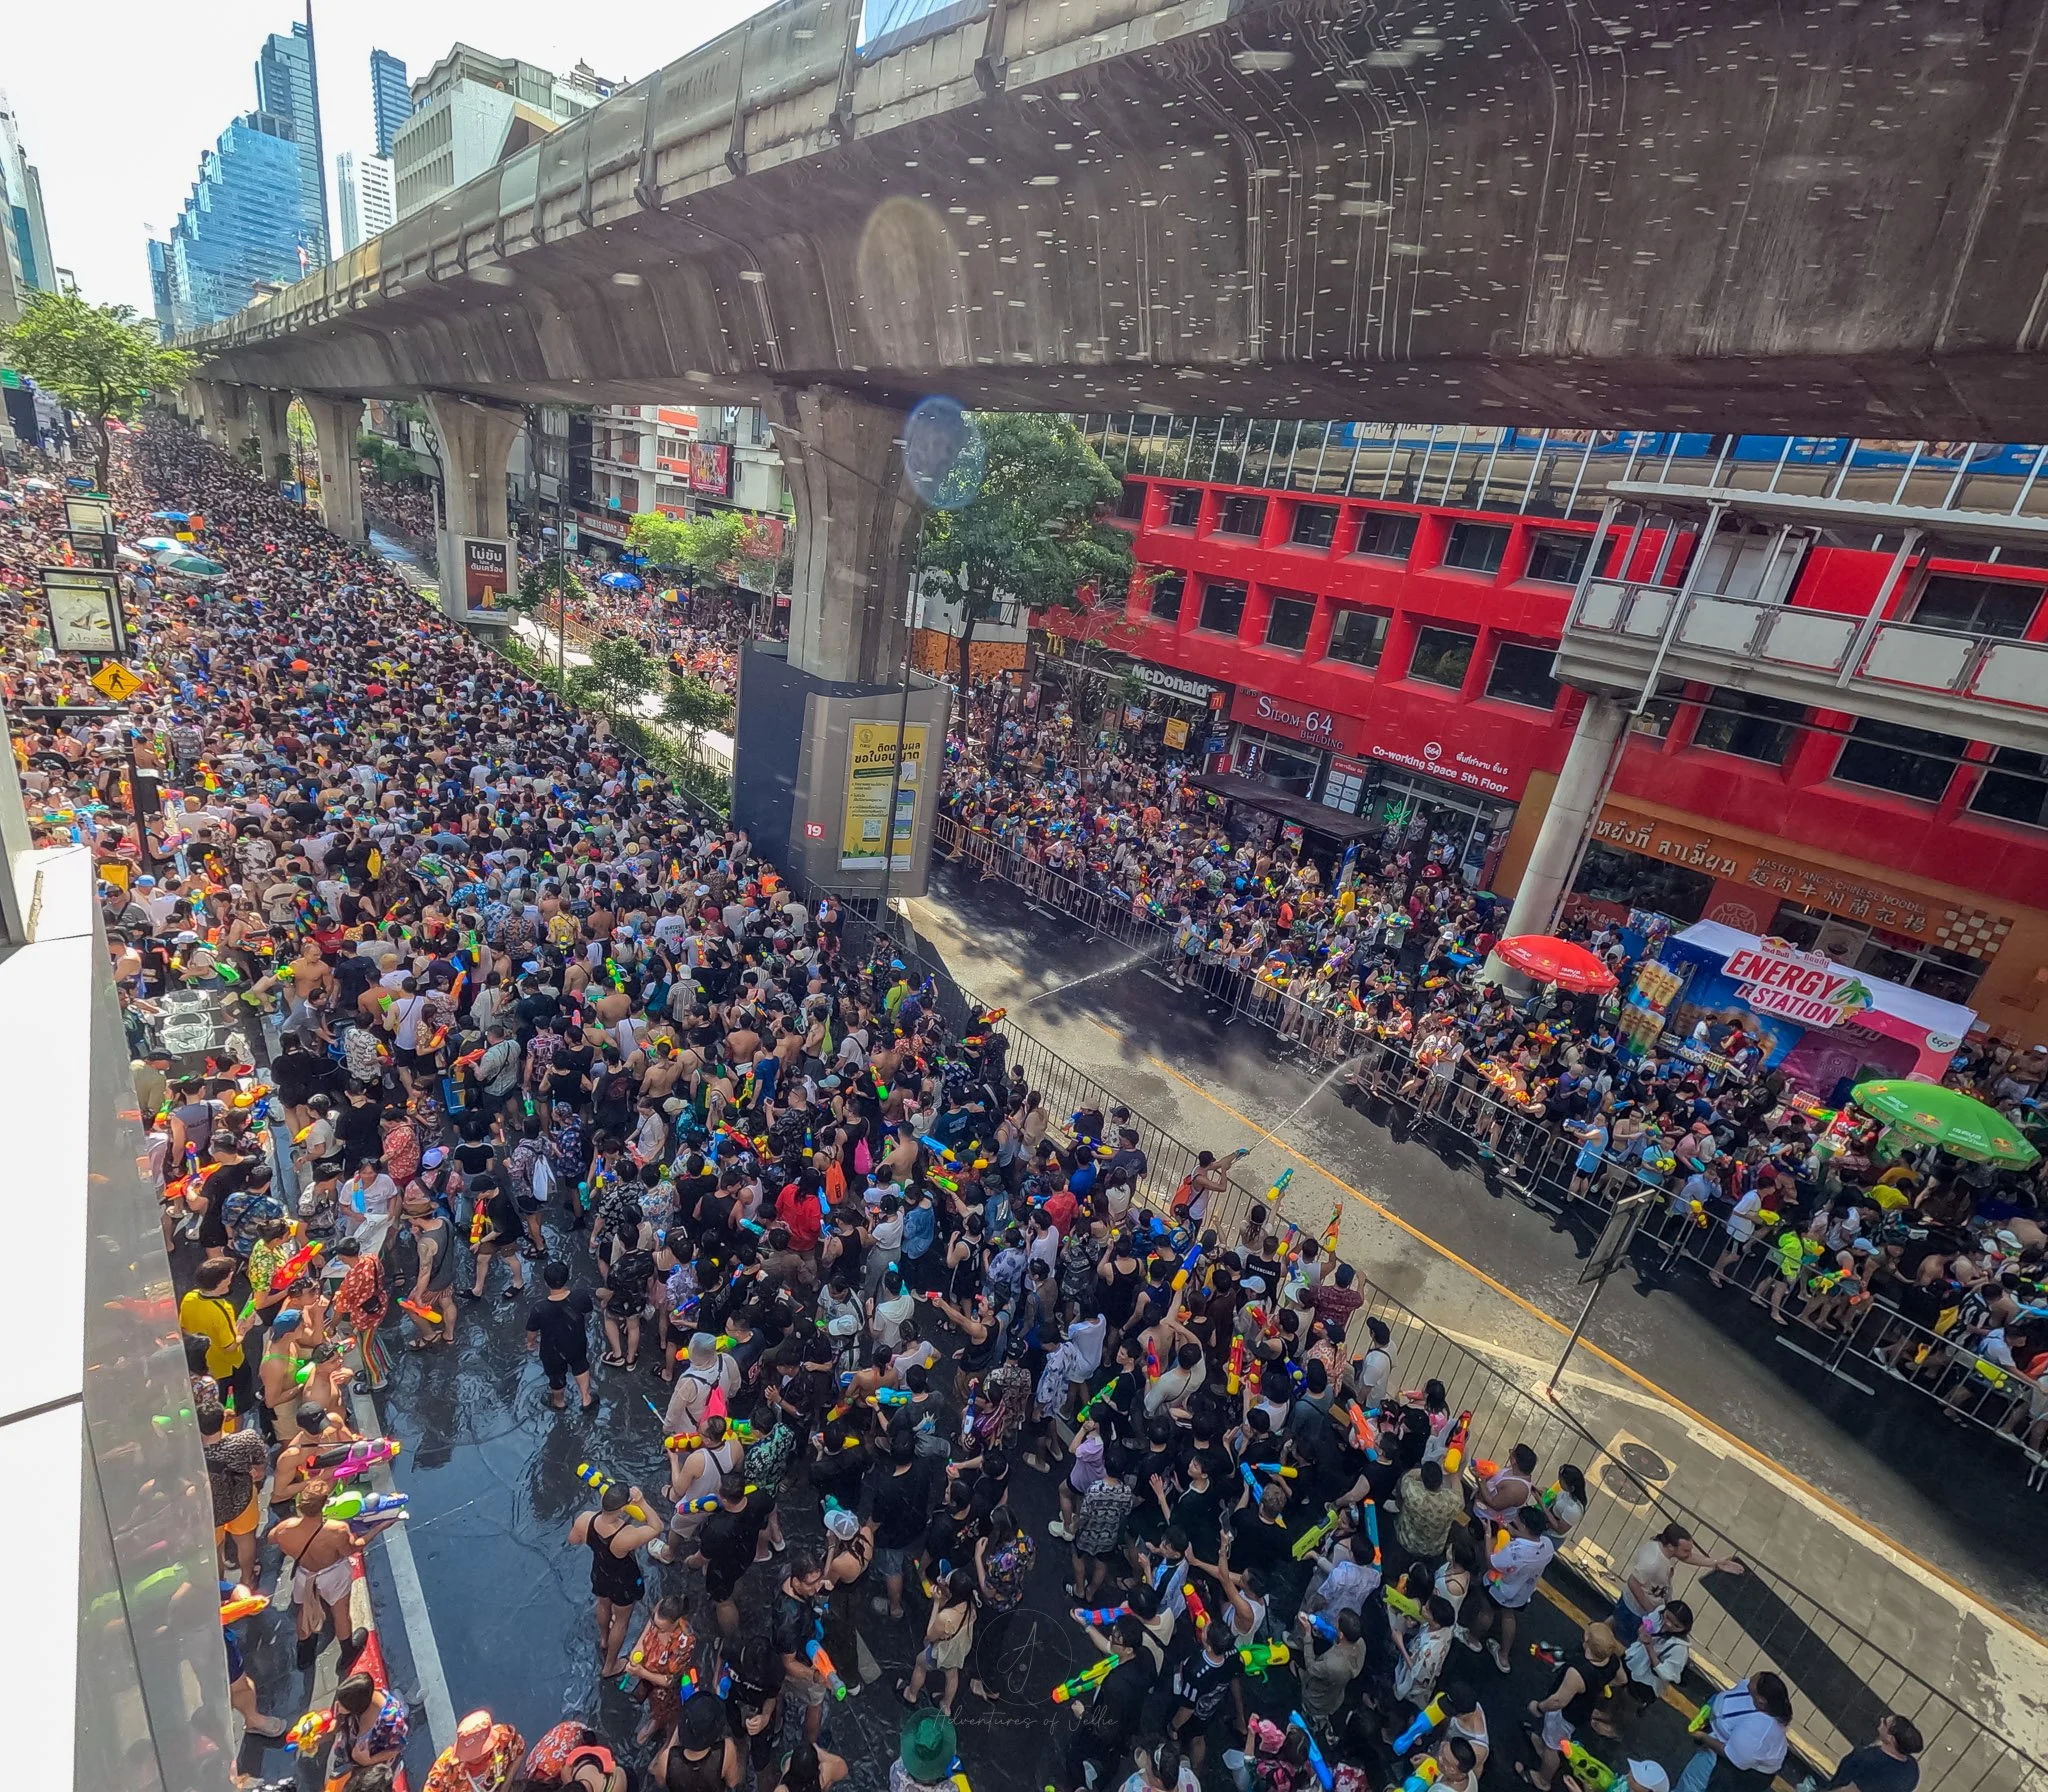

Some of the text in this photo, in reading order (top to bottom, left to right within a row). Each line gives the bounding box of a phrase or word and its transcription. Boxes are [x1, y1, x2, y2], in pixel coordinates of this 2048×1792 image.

[471, 546, 502, 562] ไม่ขับ
[470, 564, 504, 573] ดับเครื่อง
[1305, 711, 1334, 736] 64
[877, 742, 920, 753] ติดตมผล
[1299, 729, 1345, 751] BUILDING
[1372, 745, 1509, 794] Co-working Space 5th Floor
[807, 824, 821, 836] 19
[1756, 858, 1797, 876] MASTER
[1835, 881, 1880, 901] CHINESE
[1761, 945, 1790, 959] Red Bull
[1803, 953, 1830, 969] Ready
[1726, 950, 1847, 1000] ENERGY
[1752, 987, 1839, 1025] STATION
